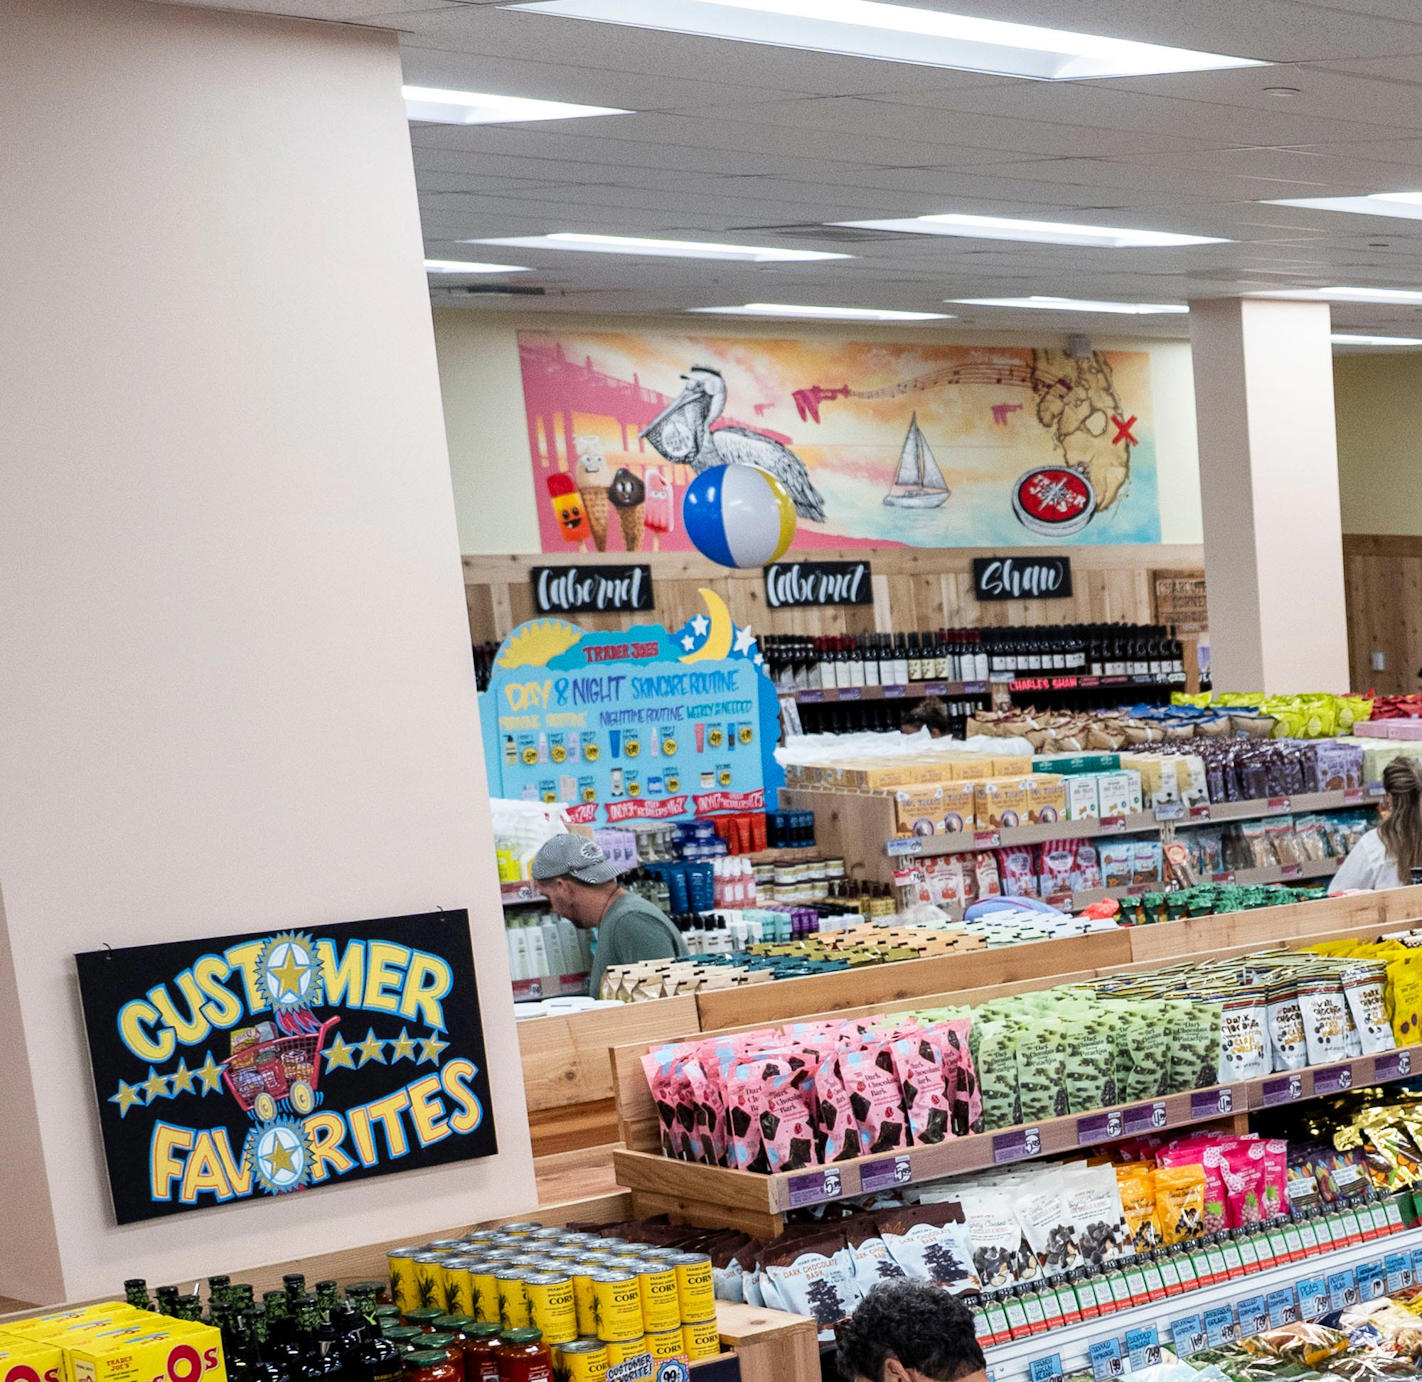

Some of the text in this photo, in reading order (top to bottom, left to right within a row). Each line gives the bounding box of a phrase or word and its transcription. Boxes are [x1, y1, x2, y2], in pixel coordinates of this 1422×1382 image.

[537, 566, 649, 611] Cabernet
[767, 563, 865, 608] Cabernet
[981, 558, 1064, 598] Shaw
[505, 667, 742, 711] DAY NIGHT SKINCARE ROUTINE
[1008, 679, 1050, 692] CHARLES
[1052, 677, 1078, 690] SHAW
[117, 929, 453, 1063] CUSTOMER
[149, 1056, 484, 1206] FAVORITES
[651, 1283, 676, 1295] CORN
[688, 1274, 713, 1286] CORN
[1300, 1282, 1319, 1297] PEAS
[614, 1291, 640, 1303] CORN
[608, 1353, 653, 1380] CUSTOMER
